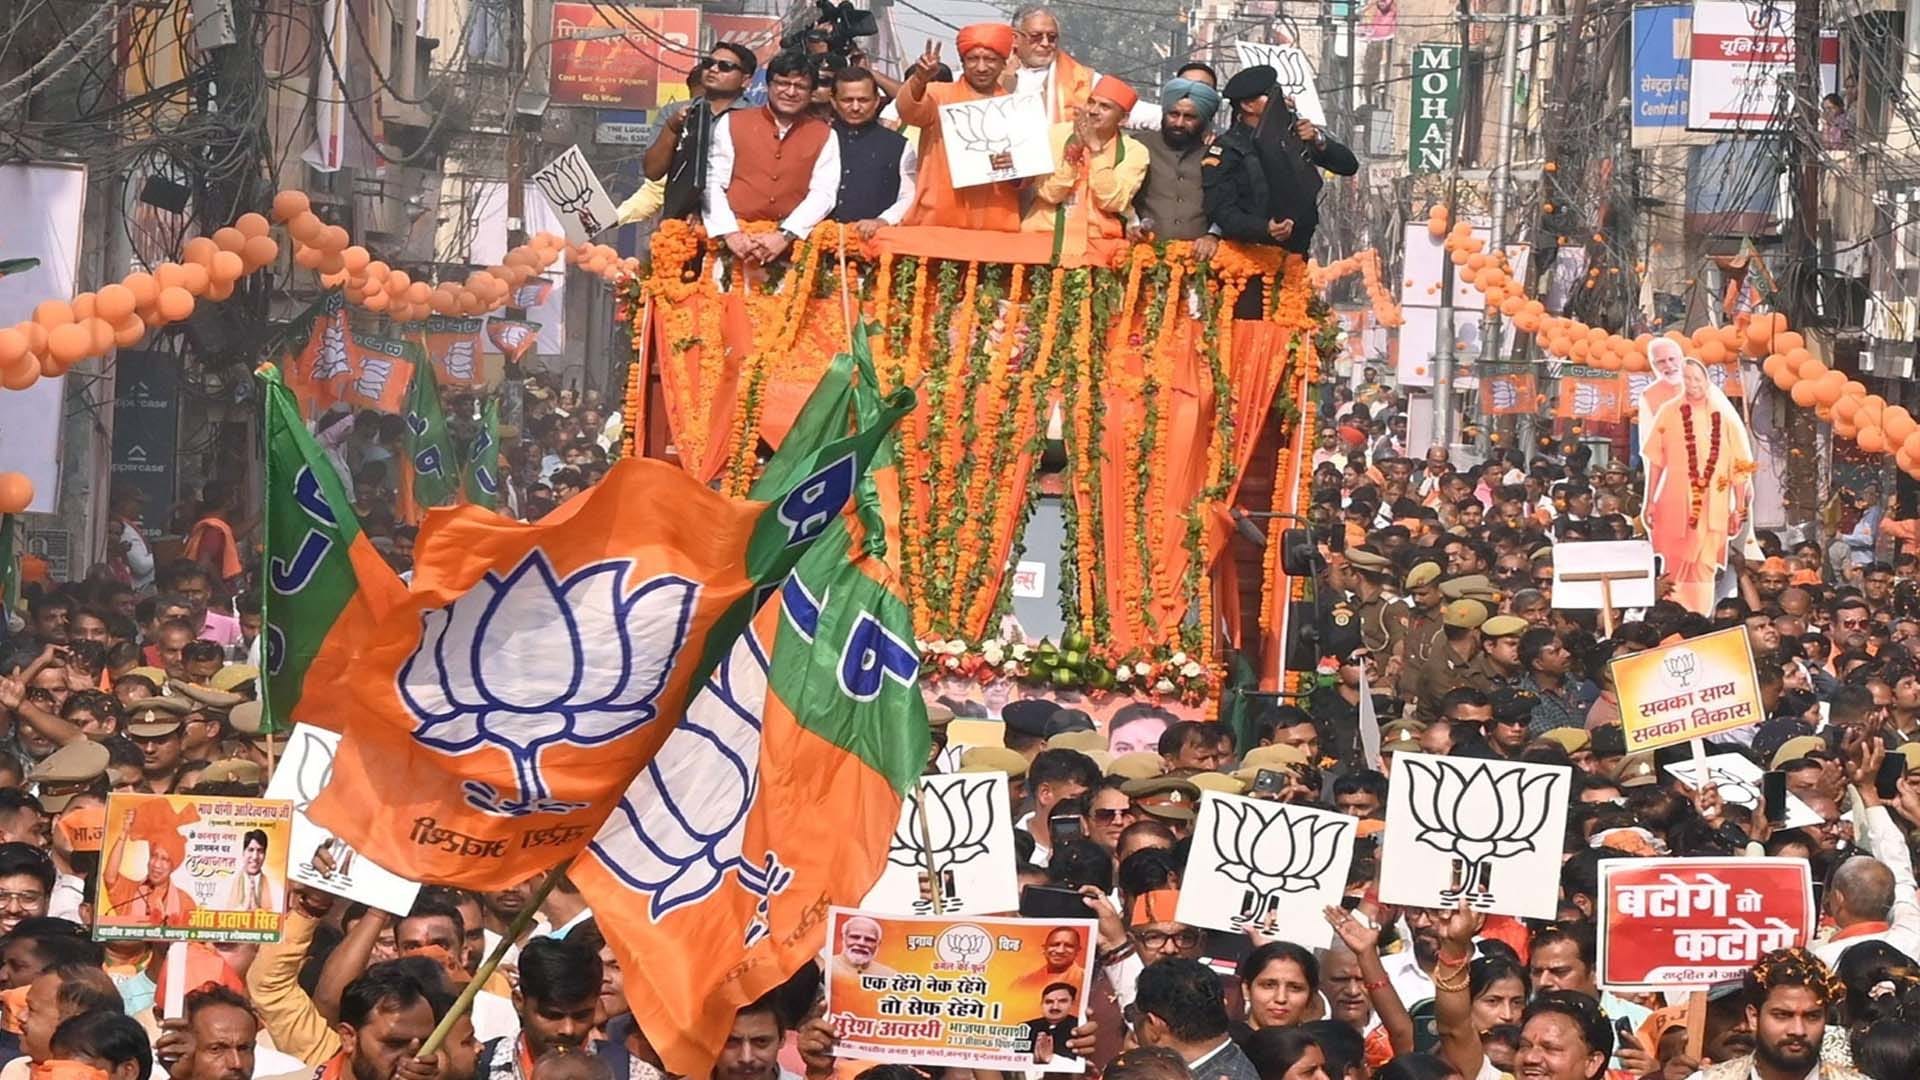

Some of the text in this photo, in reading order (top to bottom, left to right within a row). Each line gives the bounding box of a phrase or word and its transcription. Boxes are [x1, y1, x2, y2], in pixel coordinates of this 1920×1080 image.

[1419, 48, 1453, 170] MOHAN
[1641, 101, 1678, 116] Central
[1700, 682, 1735, 703] साथ
[1692, 702, 1752, 729] विकास
[1615, 873, 1763, 918] बटोगे तो
[1672, 917, 1799, 962] कटोगे
[862, 974, 987, 996] एक रहेंगे नेक रहेंगे
[881, 995, 902, 1014] तो
[907, 996, 943, 1015] सेफ
[947, 996, 986, 1019] रहेंगे
[833, 1015, 941, 1039] सुरेश अवस्थी
[949, 1022, 986, 1035] भाजपा
